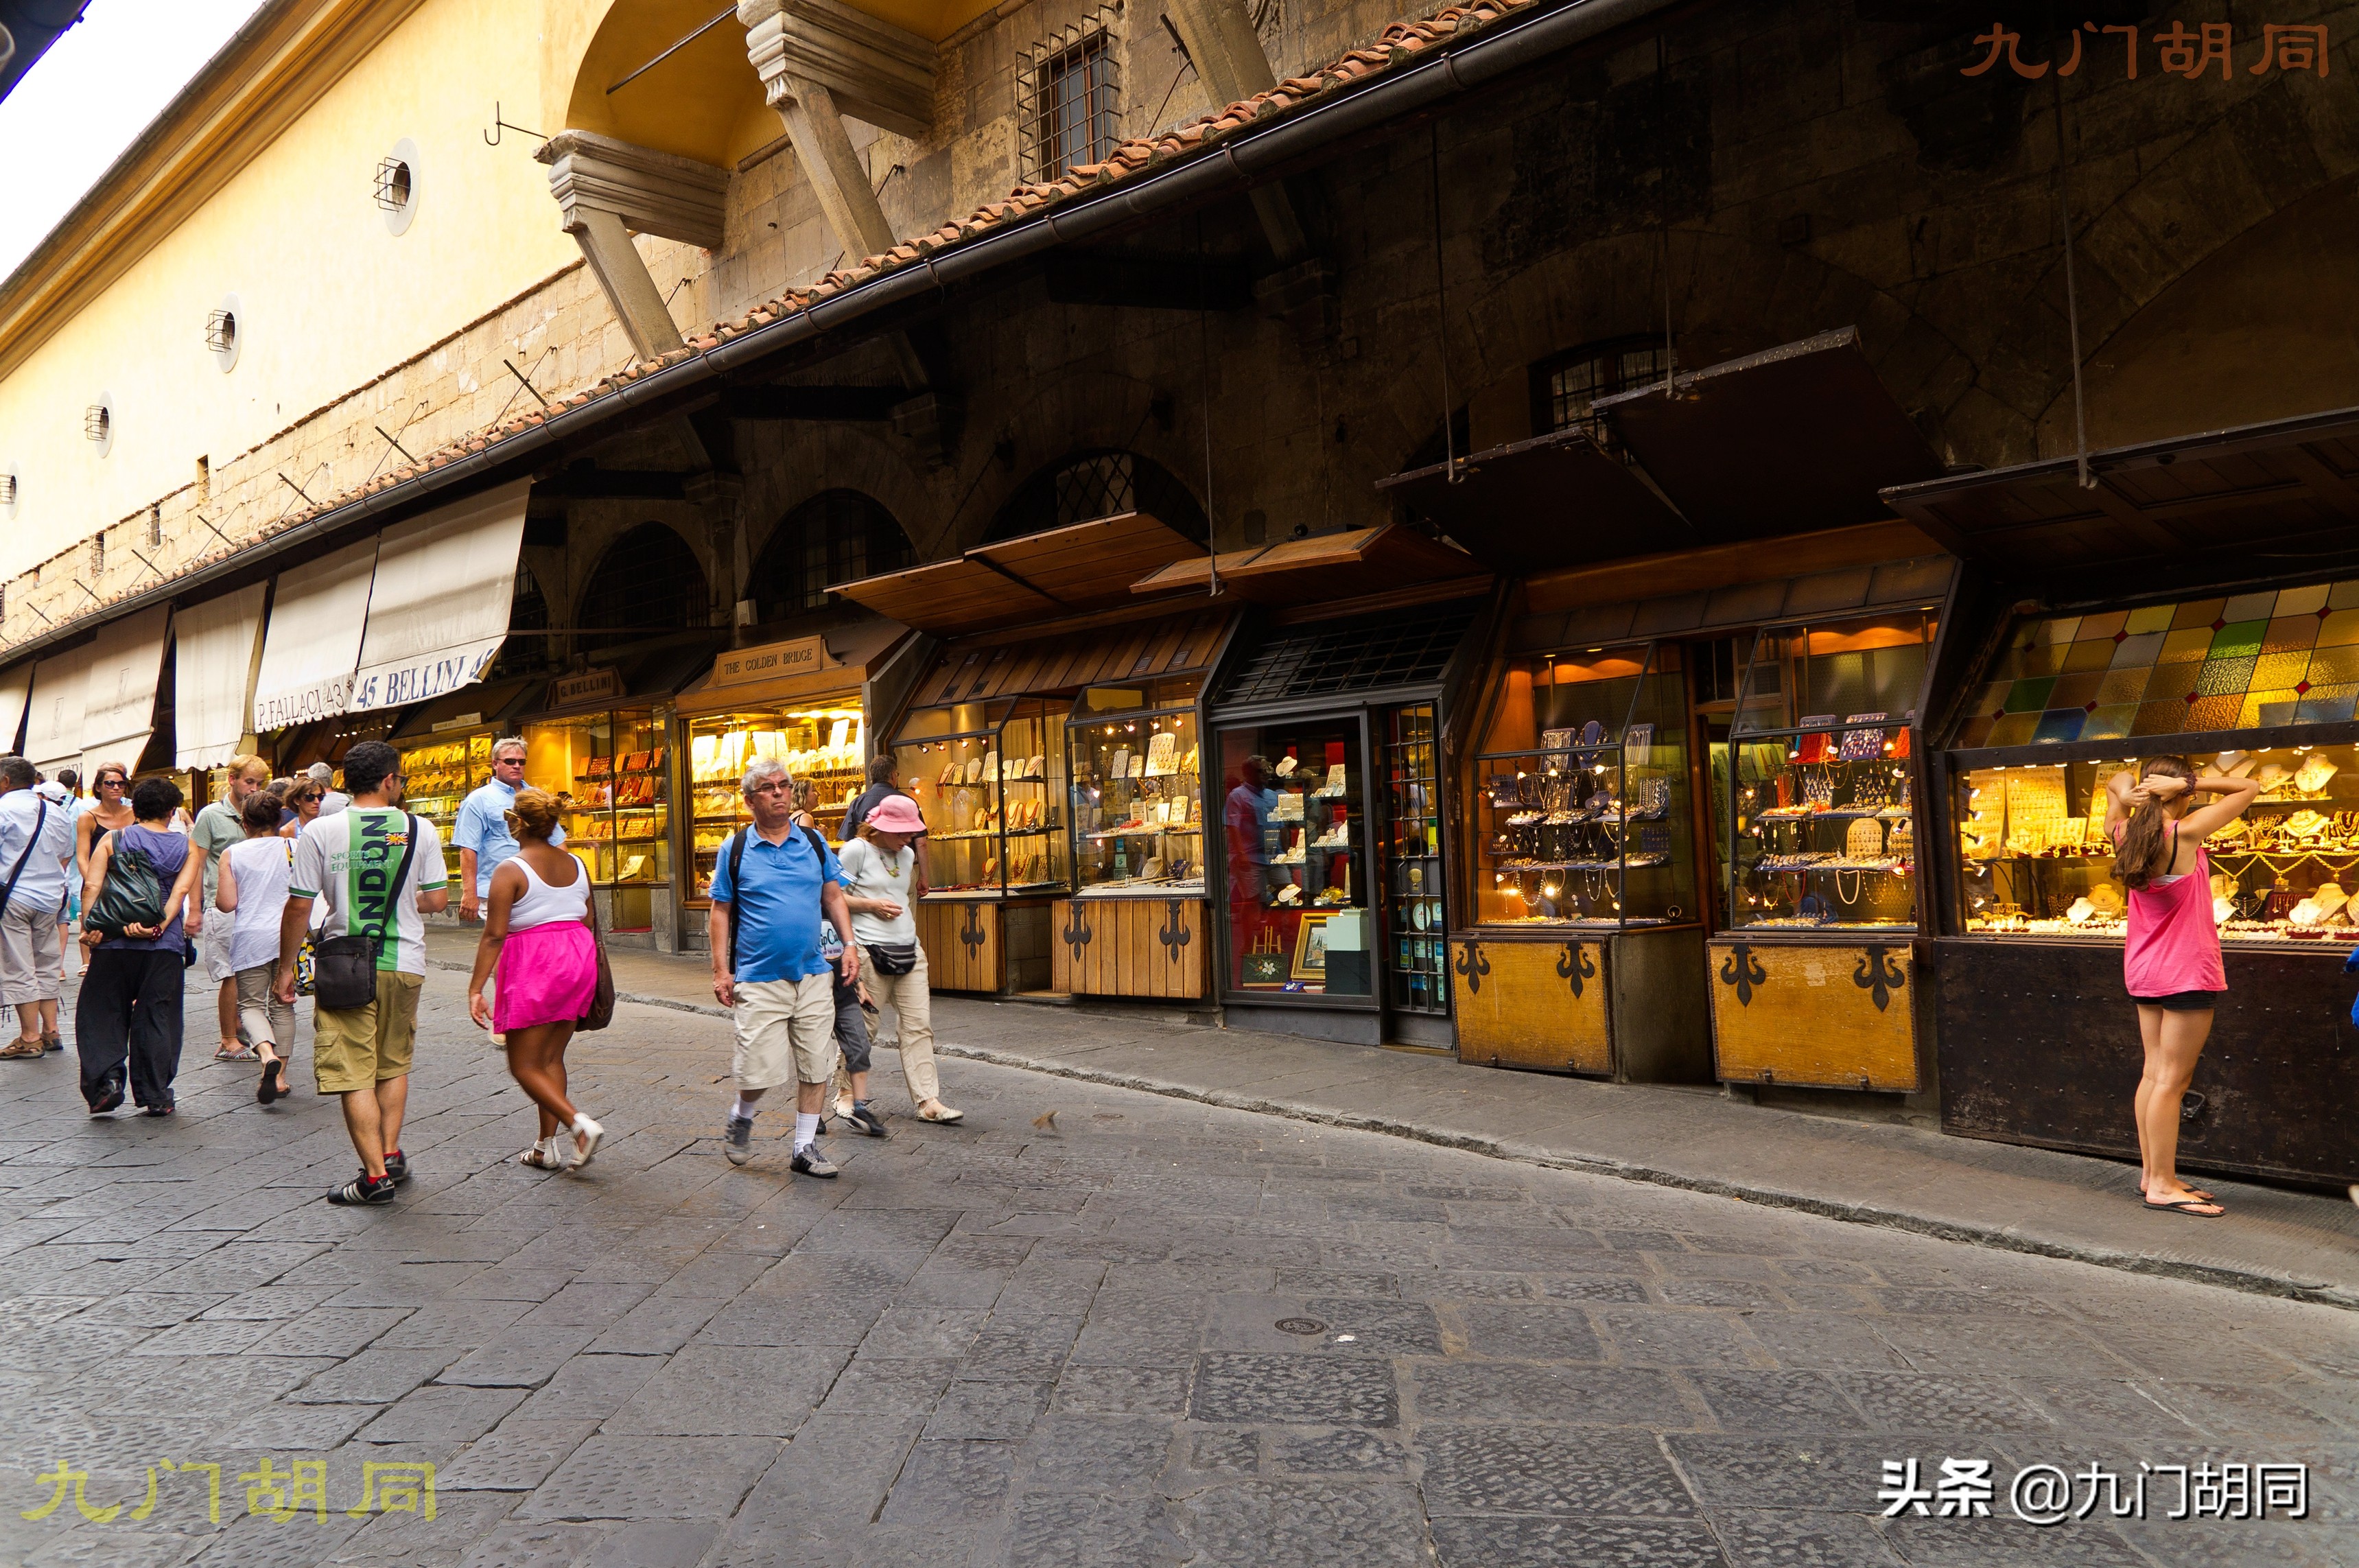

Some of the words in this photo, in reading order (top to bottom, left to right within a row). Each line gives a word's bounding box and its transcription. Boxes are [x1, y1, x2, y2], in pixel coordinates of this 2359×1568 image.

[724, 661, 740, 675] THE
[745, 654, 777, 671] GOLDEN
[783, 648, 812, 665] BRIDGE
[356, 676, 379, 709] 45
[385, 655, 467, 705] BELLINI
[570, 676, 611, 695] BELLINI
[326, 683, 344, 711] 43
[331, 850, 371, 861] SPORTS
[331, 859, 395, 873] EQUIPMENT
